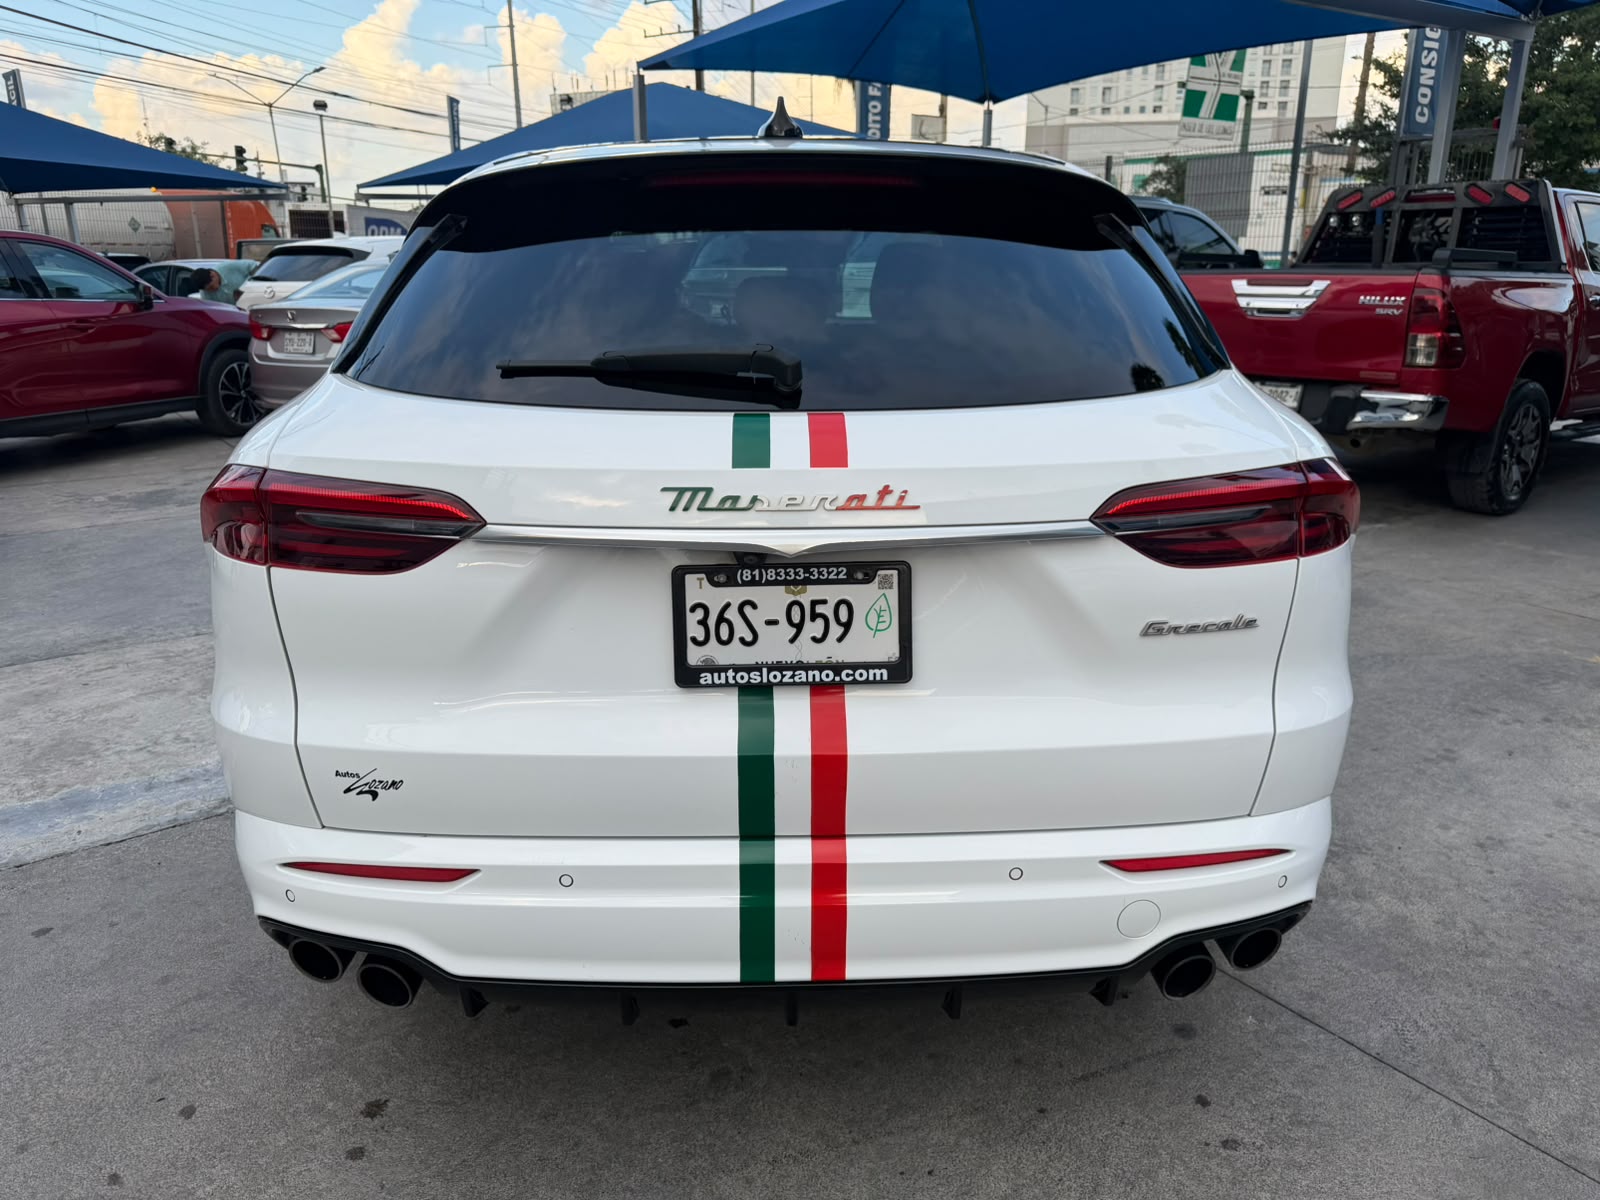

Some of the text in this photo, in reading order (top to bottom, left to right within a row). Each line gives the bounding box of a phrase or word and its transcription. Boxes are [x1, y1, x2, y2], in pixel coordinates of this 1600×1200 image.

[1359, 295, 1406, 305] HILUX
[660, 484, 921, 513] Maserati
[736, 567, 847, 584] (81)8333-3322
[689, 598, 855, 648] 36S-959
[1139, 613, 1260, 637] Grecale
[699, 667, 888, 685] autoslozano.com
[335, 770, 360, 779] Autos
